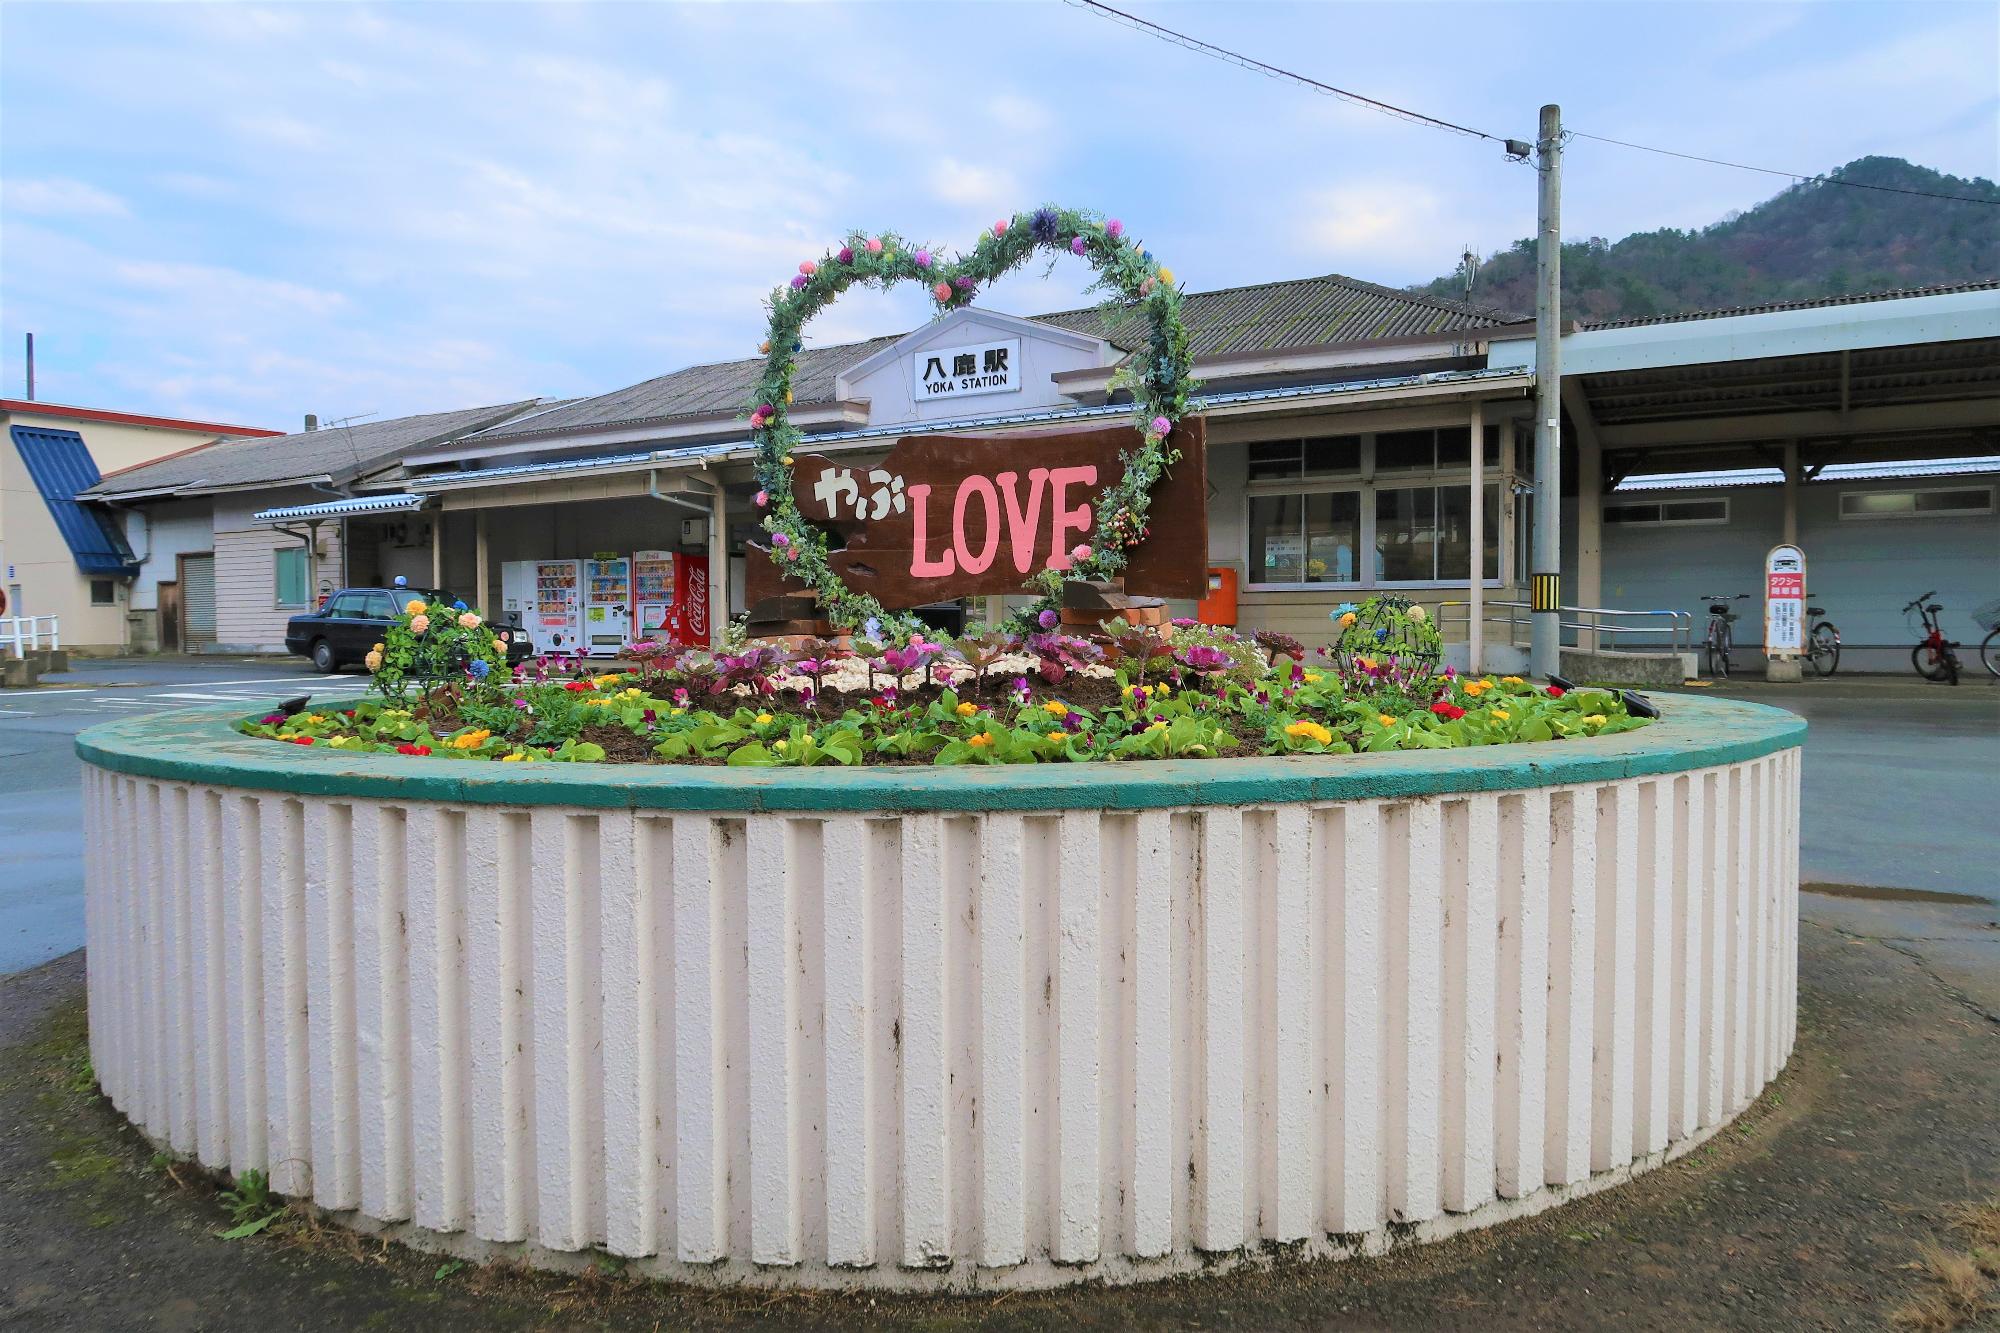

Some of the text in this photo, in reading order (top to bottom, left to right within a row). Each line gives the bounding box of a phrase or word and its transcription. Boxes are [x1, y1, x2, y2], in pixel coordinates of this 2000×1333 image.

[923, 348, 1008, 380] 八鹿駅
[962, 374, 1007, 390] STATION
[814, 466, 1097, 577] やぶ LOVE
[1771, 577, 1800, 586] タクシー
